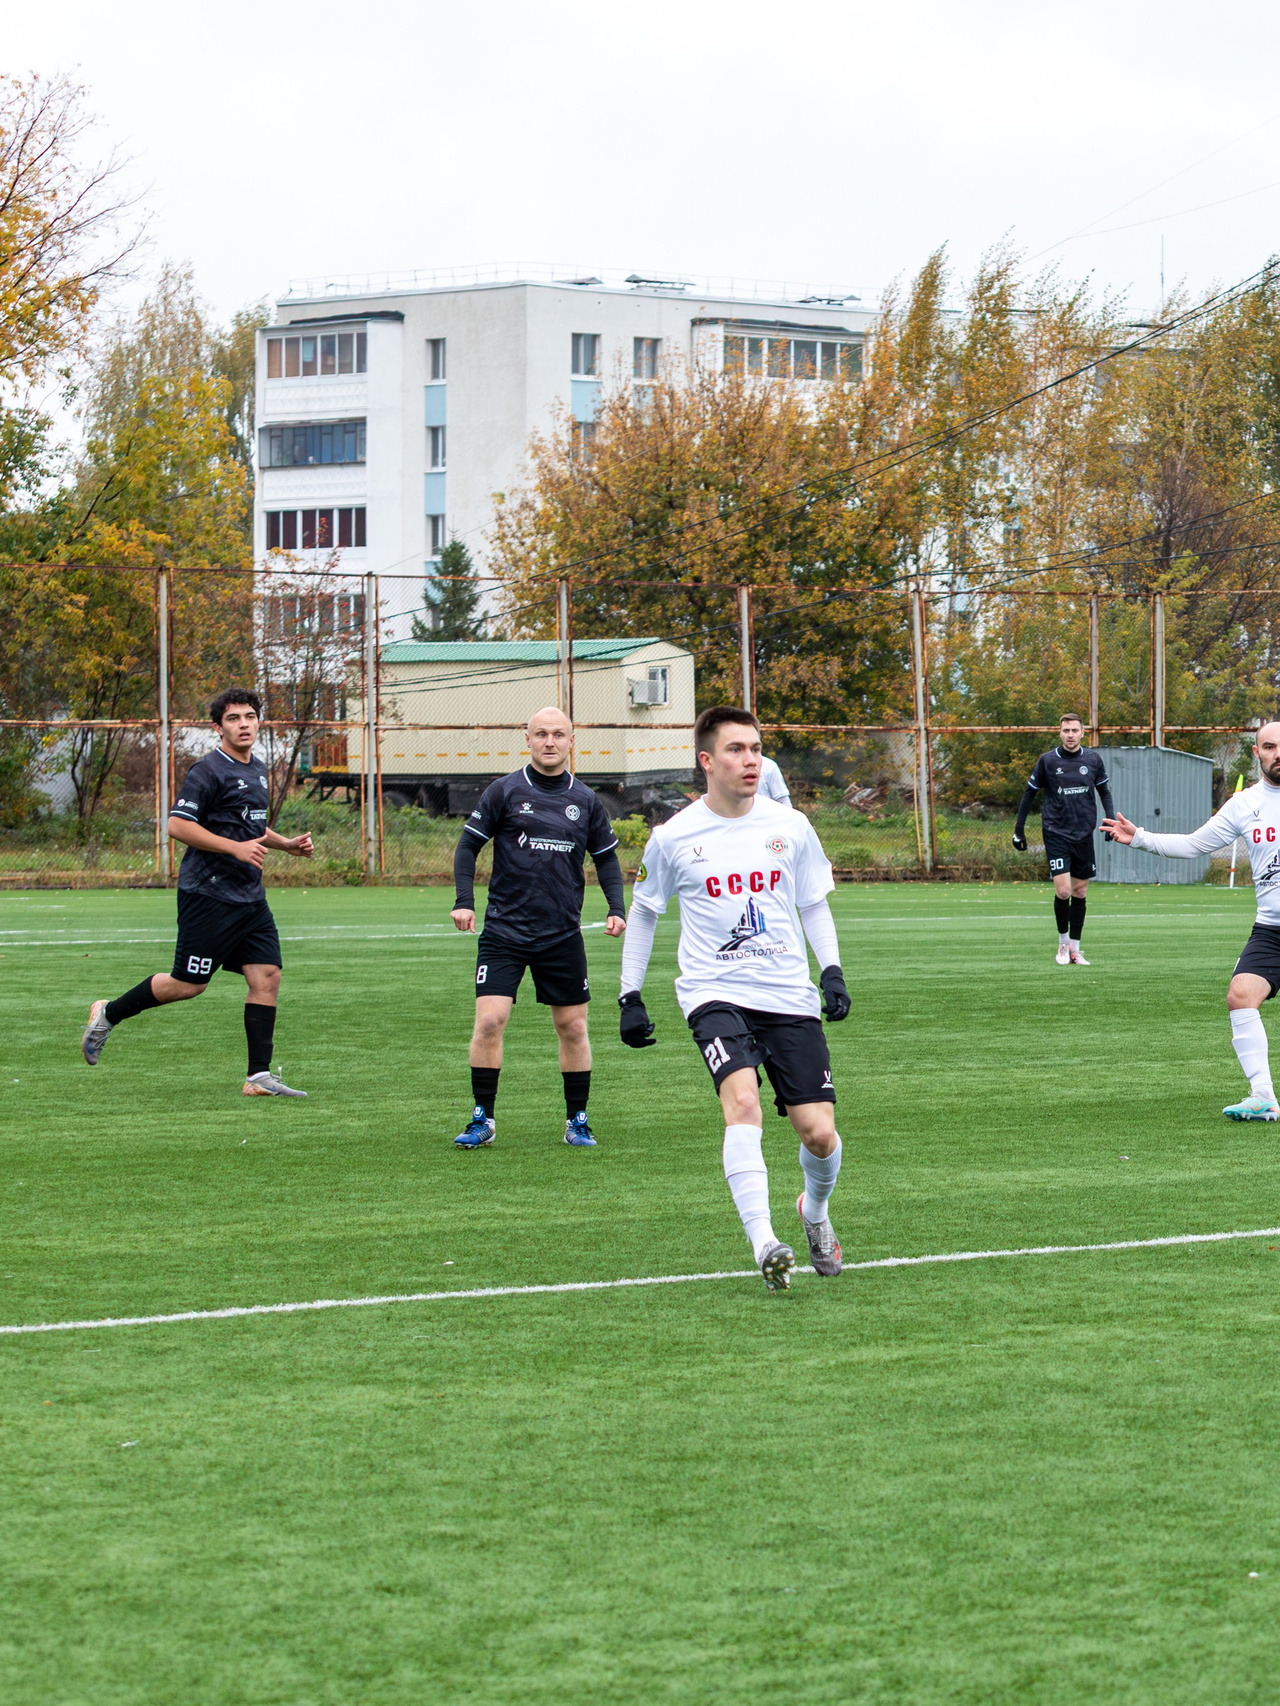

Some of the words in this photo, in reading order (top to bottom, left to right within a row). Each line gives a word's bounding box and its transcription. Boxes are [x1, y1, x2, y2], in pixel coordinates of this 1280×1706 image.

[529, 842, 575, 853] TATNEFT
[1049, 858, 1064, 870] 90
[705, 870, 781, 898] СССР
[715, 945, 788, 961] АВТОСТОЛИЦА
[187, 955, 213, 975] 69
[476, 964, 489, 984] 8
[704, 1036, 731, 1074] 21
